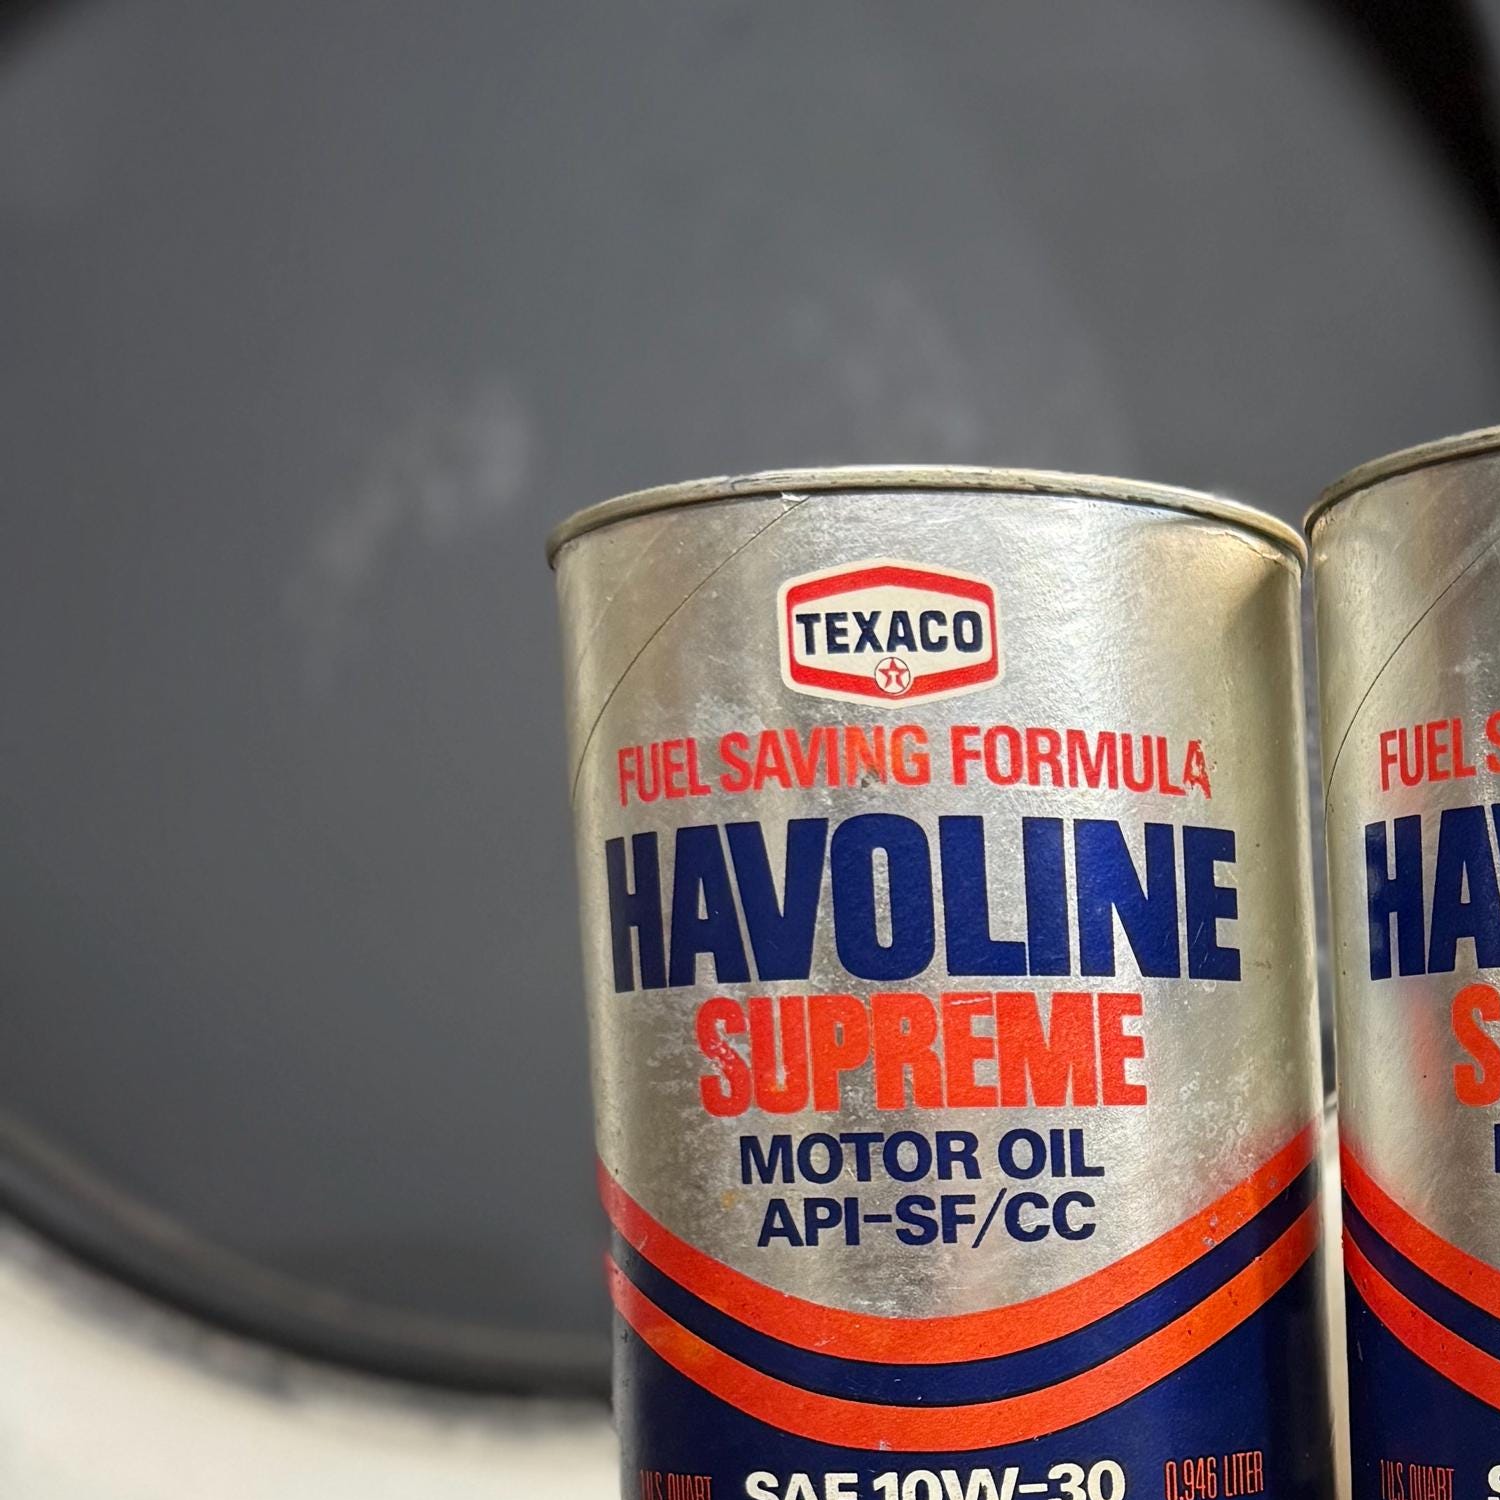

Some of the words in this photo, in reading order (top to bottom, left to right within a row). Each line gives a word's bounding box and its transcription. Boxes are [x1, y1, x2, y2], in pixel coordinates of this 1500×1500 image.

[796, 611, 983, 655] TEXACO
[617, 738, 710, 806] FUEL
[720, 726, 930, 791] SAVING
[951, 726, 1213, 799] FORMULA
[1379, 719, 1476, 791] FUEL
[606, 813, 1241, 993] HAVOLINE
[695, 992, 1147, 1118] SUPREME
[740, 1130, 982, 1184] MOTOR
[998, 1128, 1105, 1179] OIL
[757, 1188, 1097, 1249] API-SF/CC
[1223, 1451, 1265, 1496] LITER
